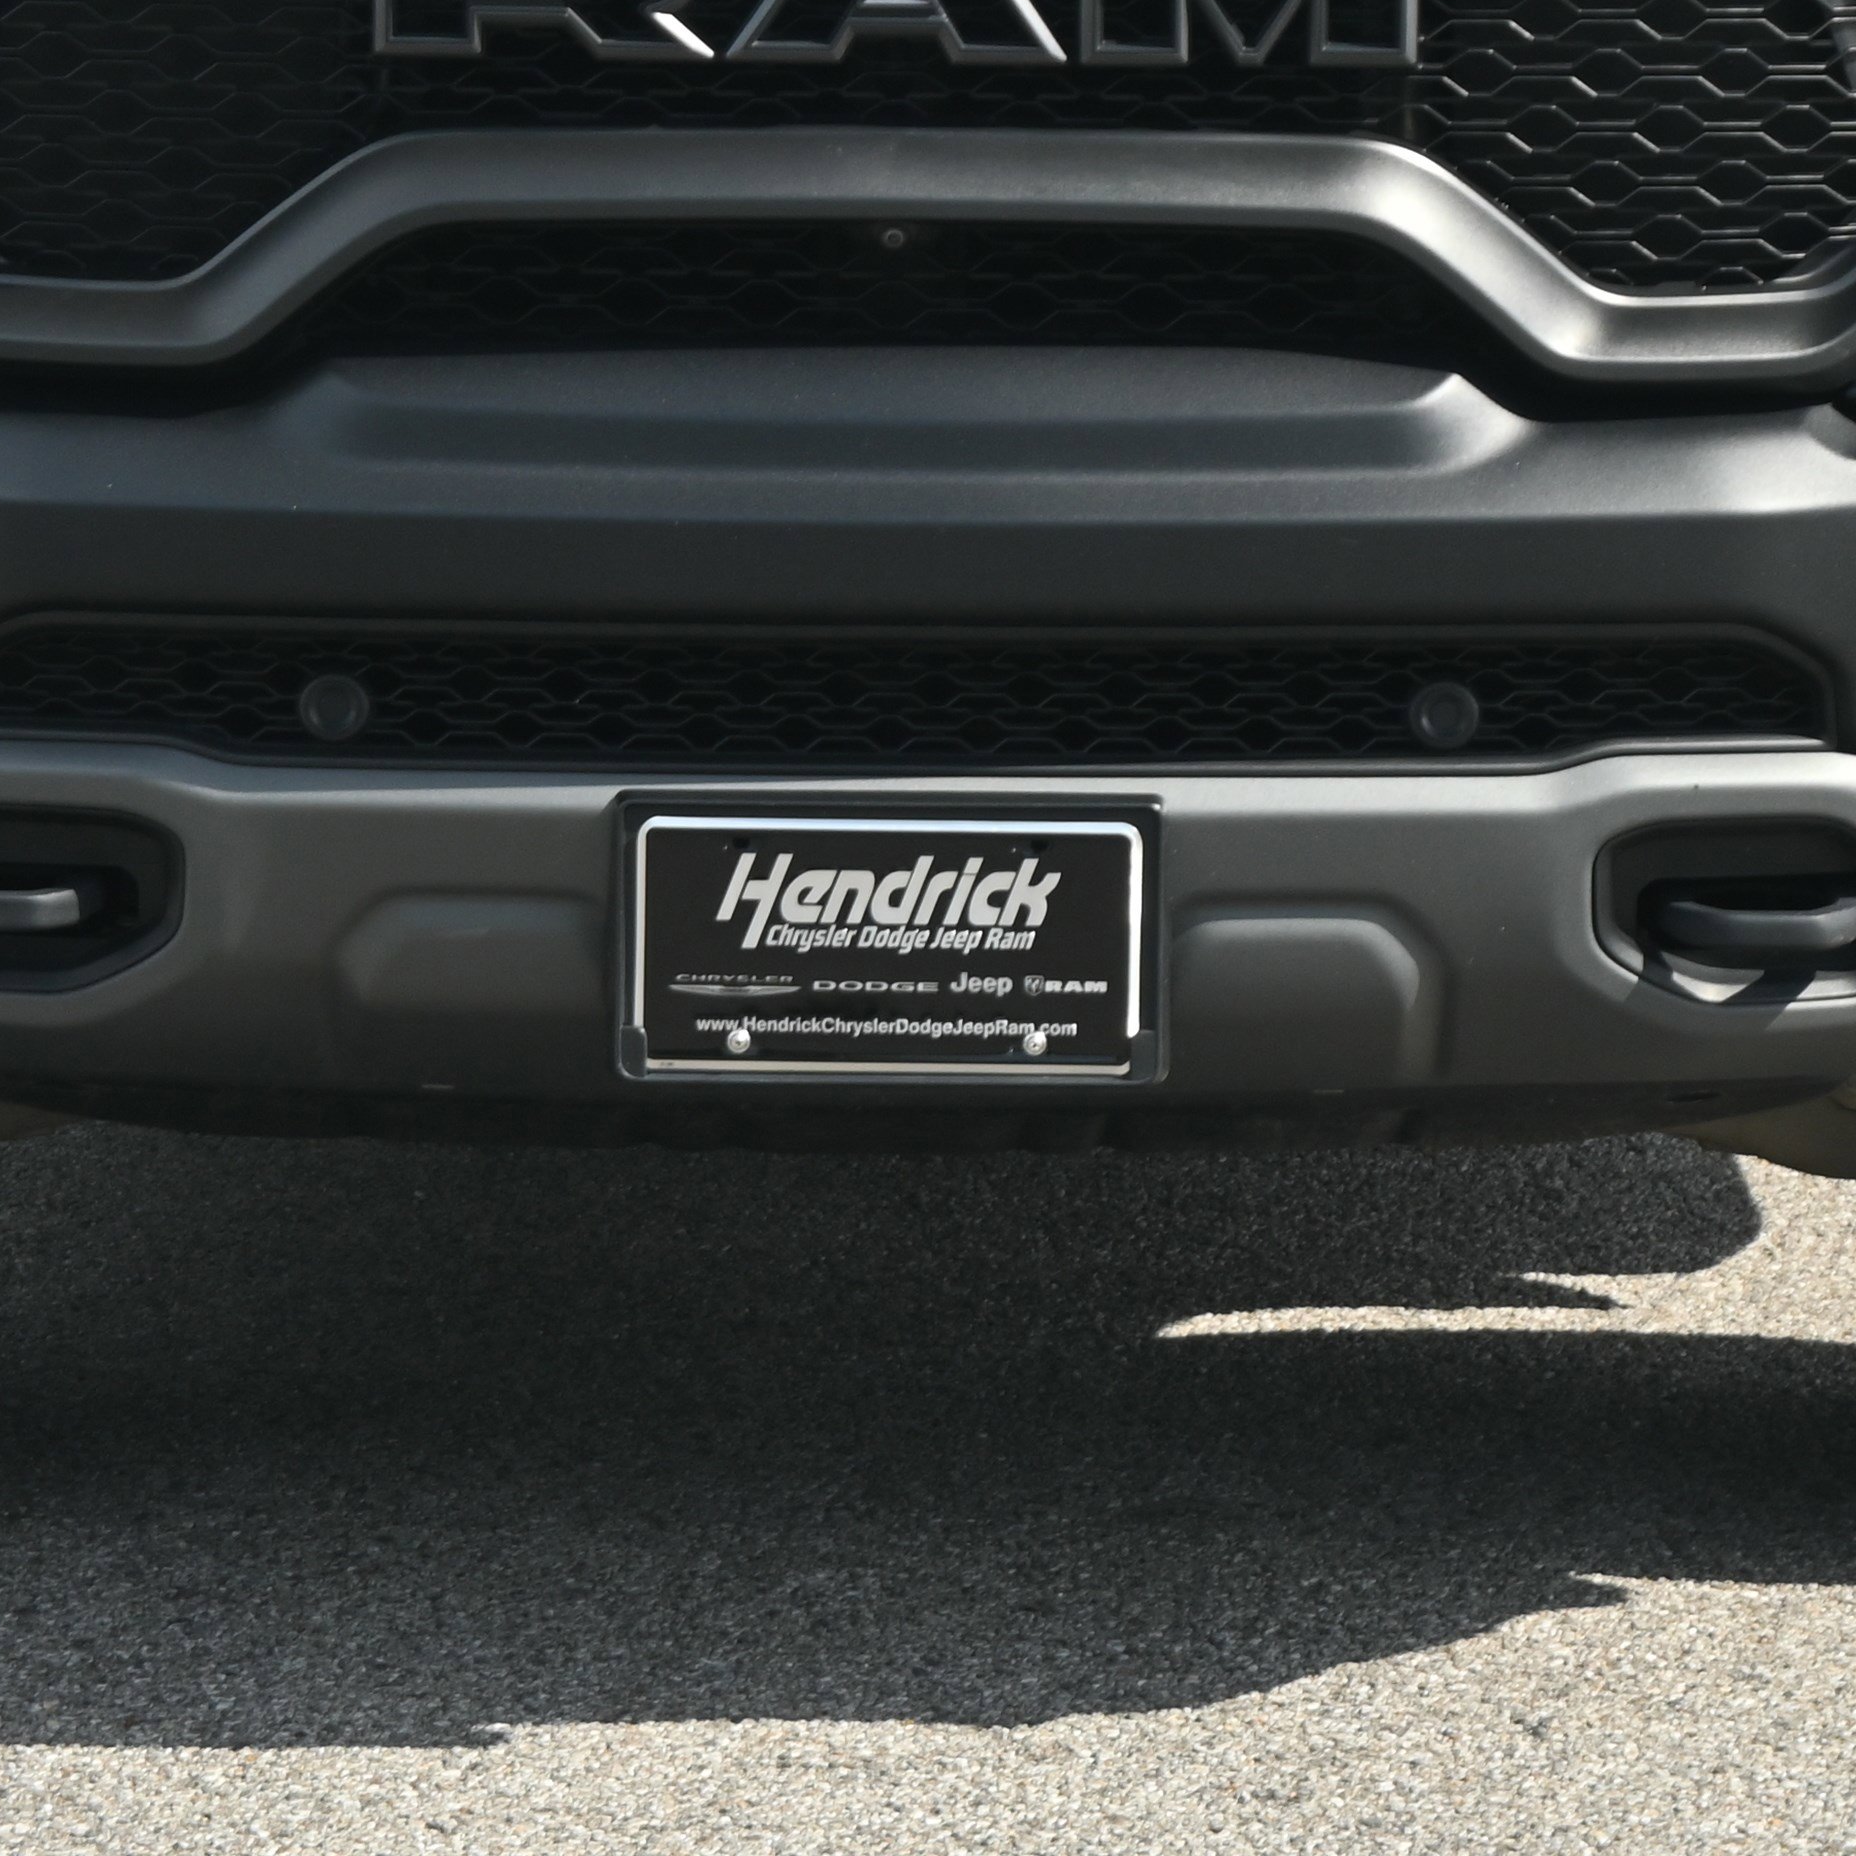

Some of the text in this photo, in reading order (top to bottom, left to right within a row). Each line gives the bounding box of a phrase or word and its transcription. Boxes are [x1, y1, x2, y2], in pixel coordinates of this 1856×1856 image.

[715, 852, 1062, 949] Hendrick
[765, 924, 1036, 955] Chrysler Dodge Jeep Ram
[675, 971, 1108, 997] CHRYSLER DODGE Jeep RAM
[695, 1016, 1078, 1039] wwwHendrickChryslerDodgeJeepRamcom
